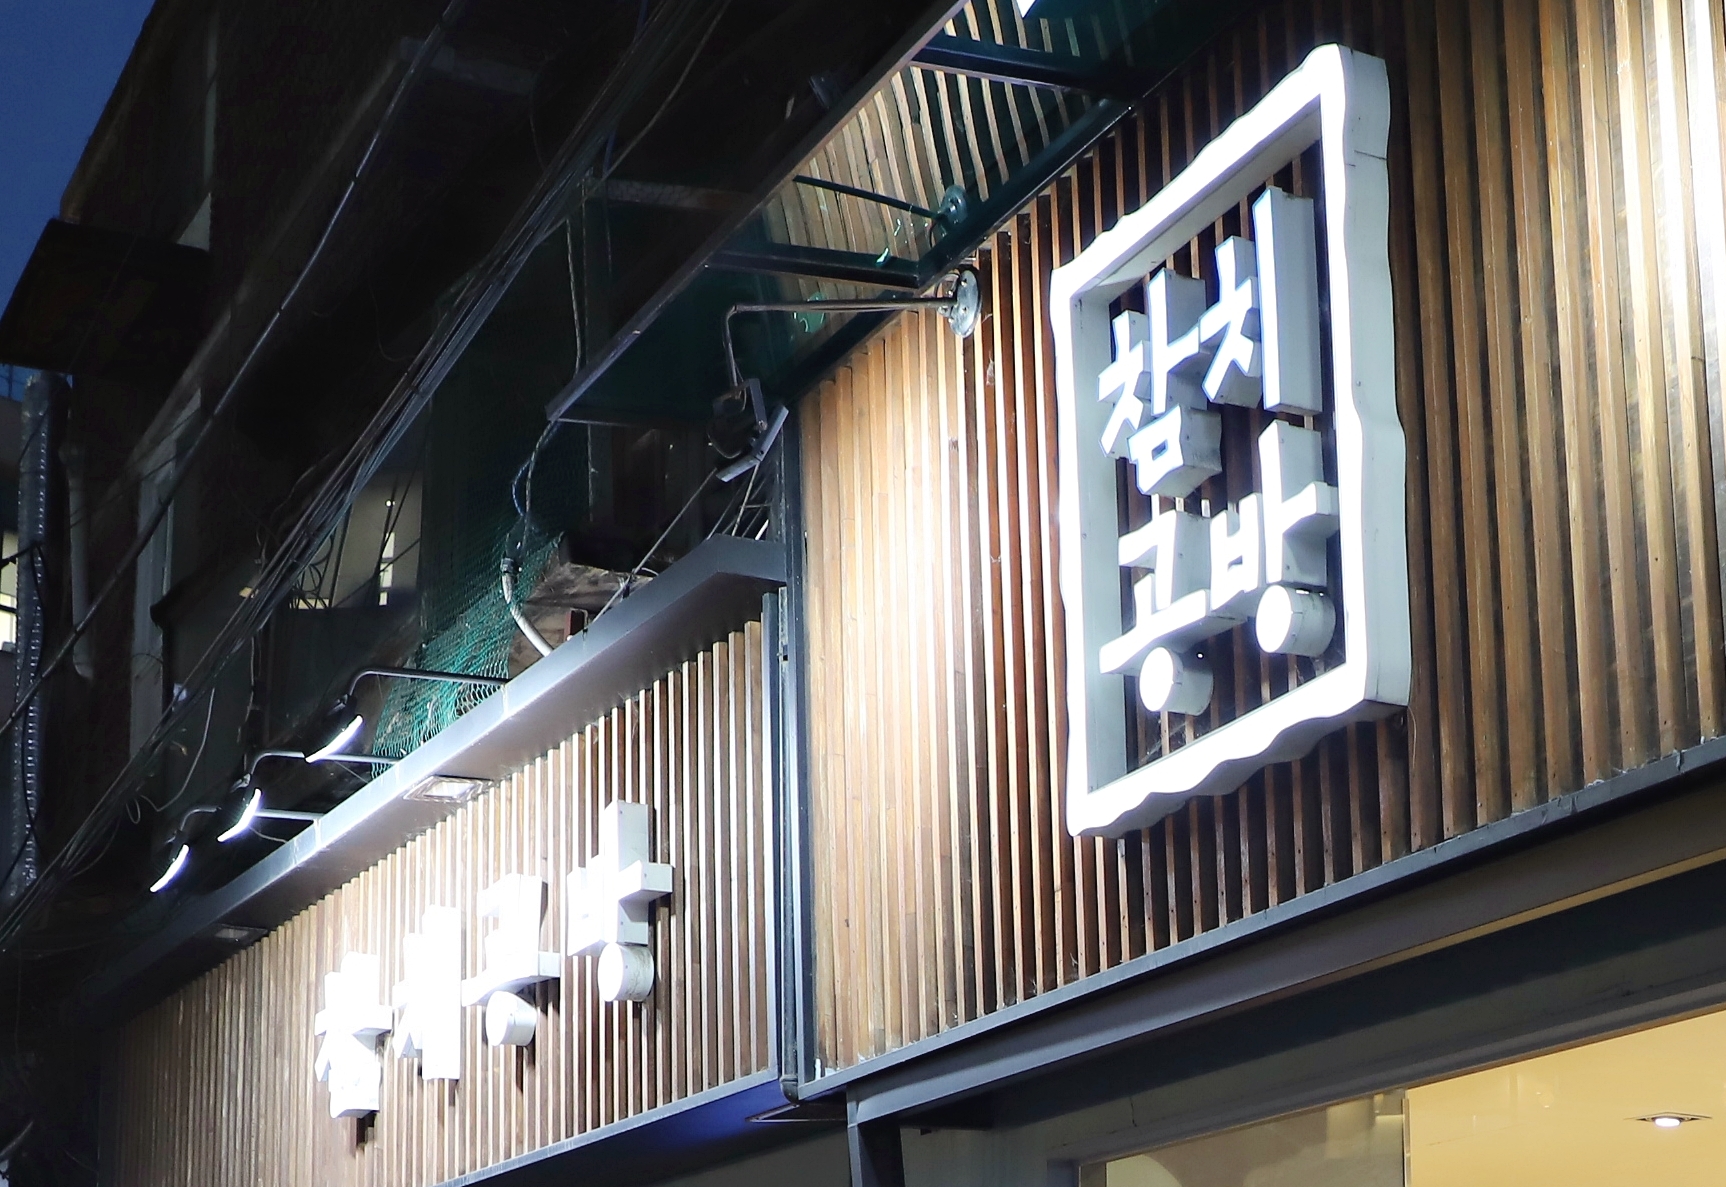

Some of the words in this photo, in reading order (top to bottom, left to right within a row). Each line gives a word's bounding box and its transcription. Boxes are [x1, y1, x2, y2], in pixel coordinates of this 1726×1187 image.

[1098, 186, 1288, 496] 참치
[1100, 419, 1320, 713] 공방
[315, 800, 673, 1118] 참치공방
